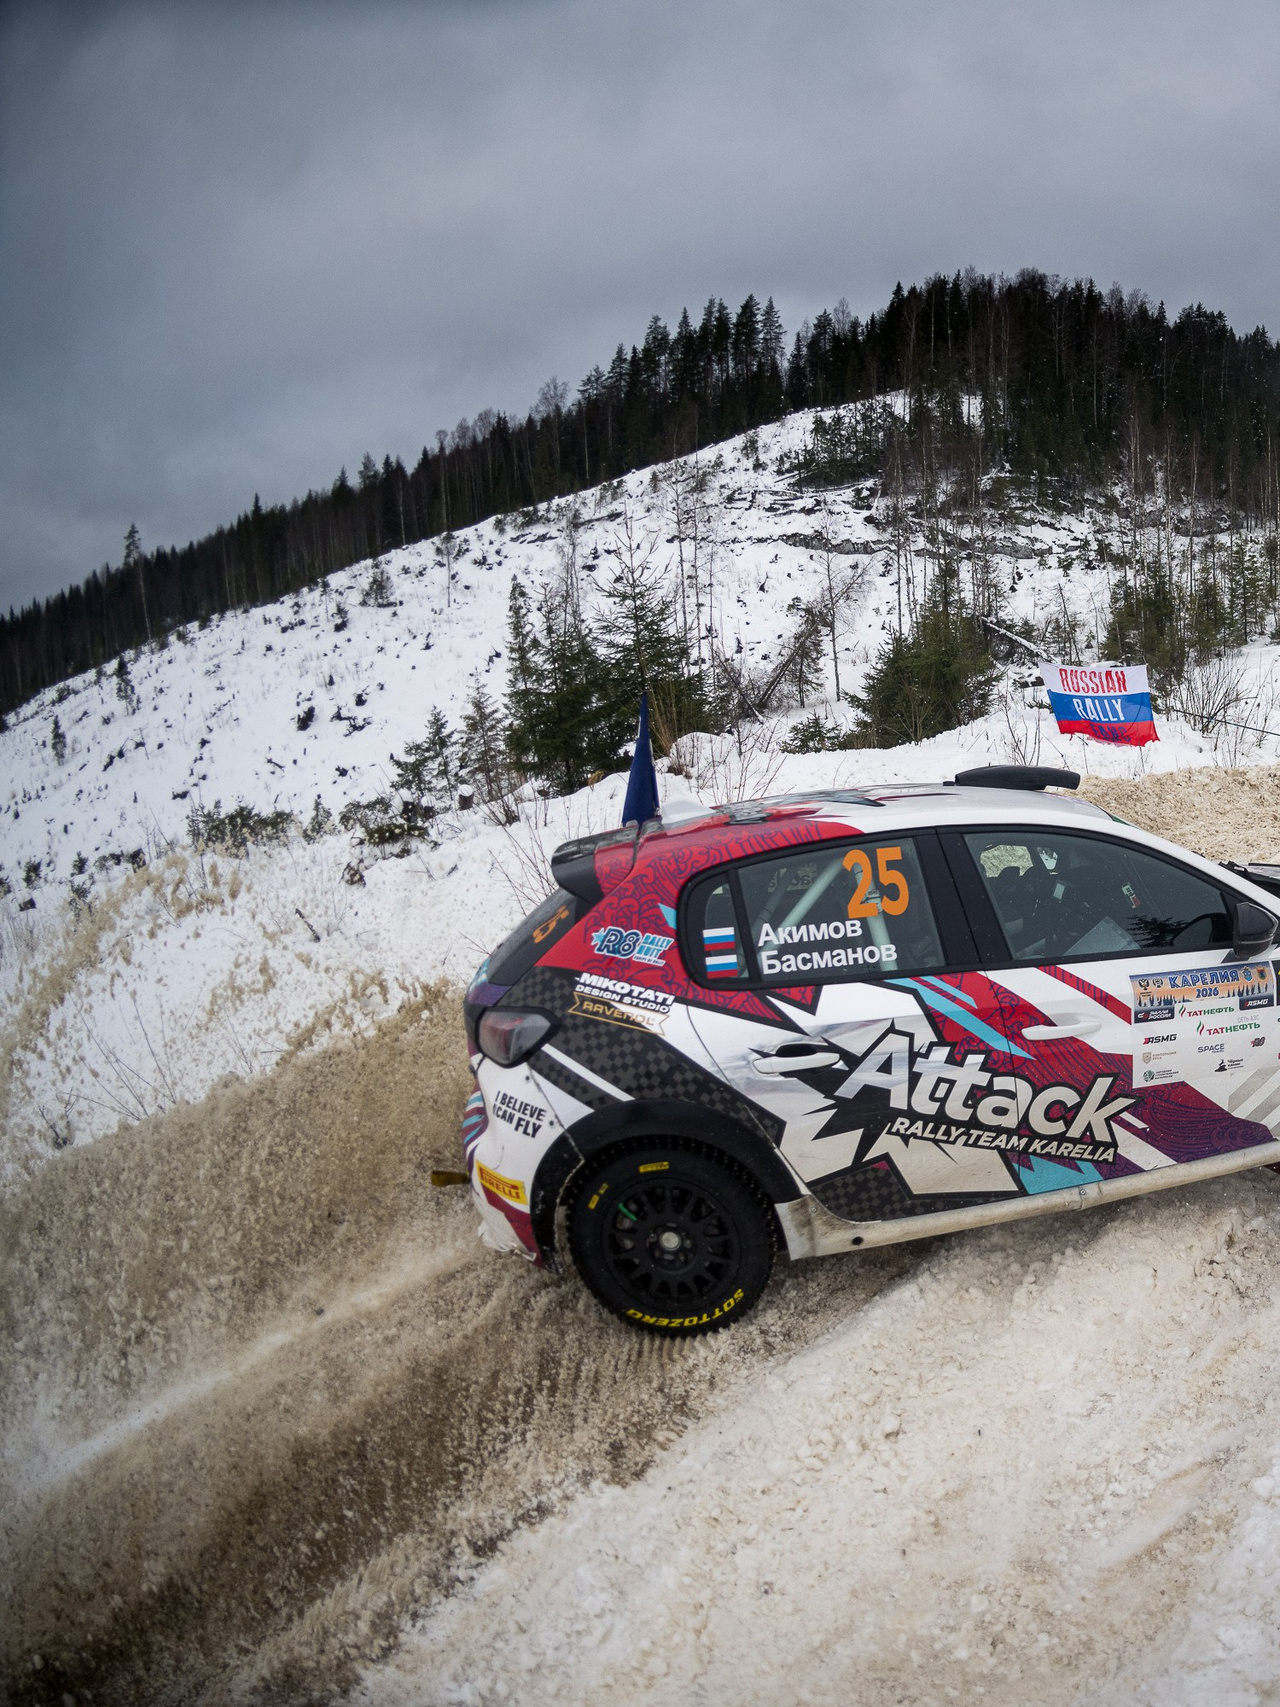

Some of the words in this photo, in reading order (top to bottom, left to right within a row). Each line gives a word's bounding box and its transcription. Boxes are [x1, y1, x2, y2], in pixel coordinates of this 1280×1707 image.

[1059, 668, 1128, 694] RUSSIAN
[1072, 698, 1125, 722] RALLY
[842, 846, 910, 919] 25
[595, 926, 642, 958] R8
[757, 919, 863, 947] Акимов
[760, 943, 898, 975] Басманов
[576, 972, 675, 1005] MIKOTATI
[1168, 969, 1240, 989] КАРЕЛИЯ
[1195, 986, 1220, 999] 2026
[575, 984, 621, 1002] DESIGN
[622, 996, 670, 1013] STUDIO
[1187, 1006, 1235, 1018] ТАТНЕФТЬ
[582, 1001, 655, 1026] RAVENOL
[1145, 1034, 1177, 1045] ASMG
[1206, 1022, 1261, 1036] ТАТНЕФТЬ
[1198, 1043, 1225, 1053] SPACE
[833, 1031, 1137, 1142] Attack
[494, 1090, 501, 1102] I
[500, 1092, 547, 1122] BELIEVE
[496, 1106, 516, 1125] CAN
[514, 1116, 542, 1139] FLY
[891, 1116, 967, 1146] RALLY
[967, 1129, 1030, 1151] TEAM
[1026, 1138, 1116, 1162] KARELIA
[479, 1165, 521, 1200] PIRELLI
[625, 1288, 745, 1328] SOTTOZERO
